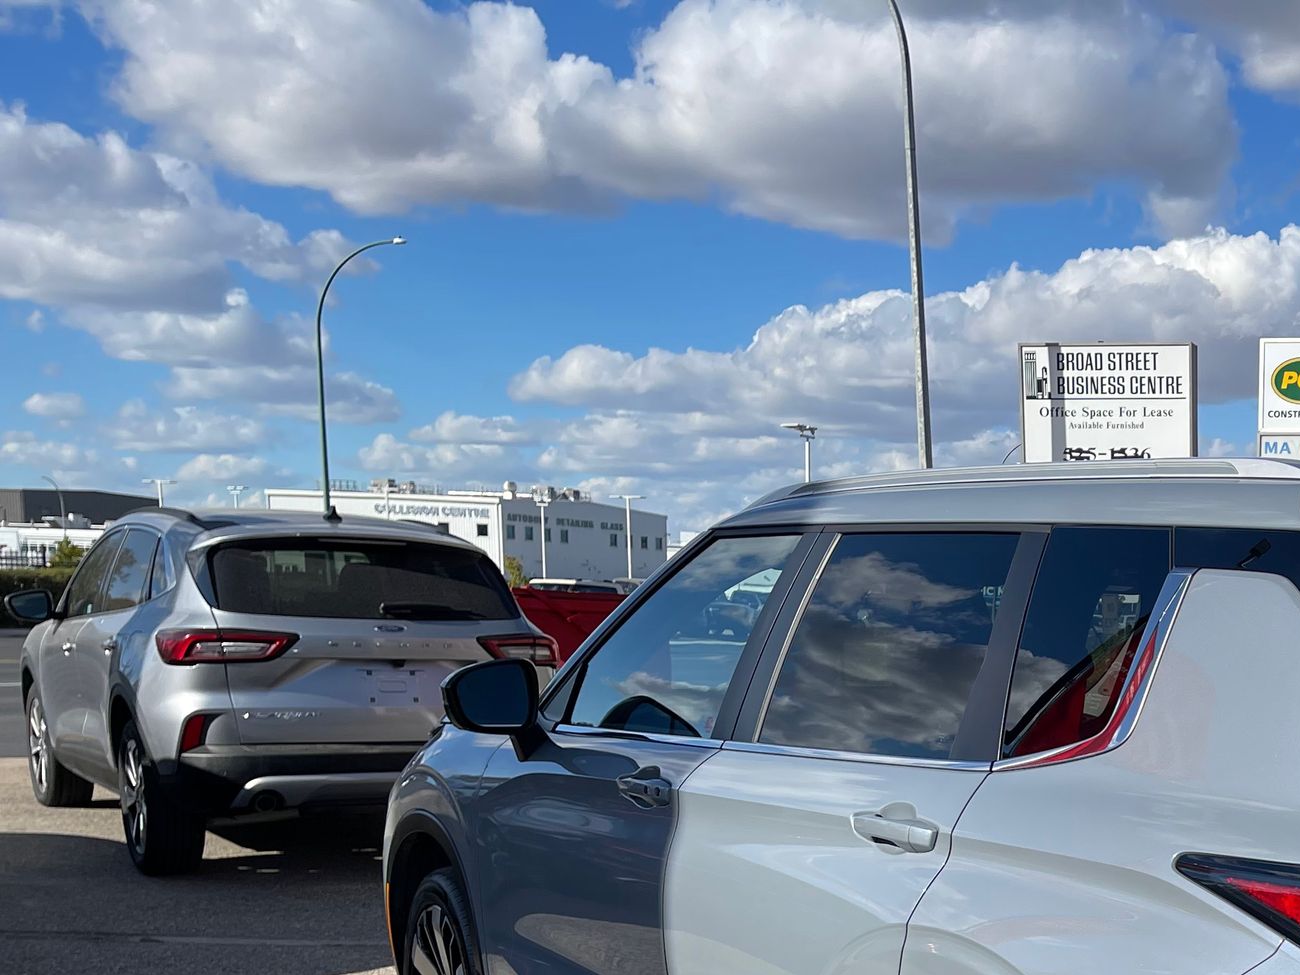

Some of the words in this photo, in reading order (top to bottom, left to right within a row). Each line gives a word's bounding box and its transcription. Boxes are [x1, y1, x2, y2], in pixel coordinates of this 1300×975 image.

[1057, 352, 1103, 371] BROAD
[1108, 352, 1159, 371] STREET
[1057, 376, 1125, 395] BUSINESS
[1130, 376, 1183, 395] CENTRE
[1039, 406, 1077, 418] Office
[1081, 406, 1114, 420] Space
[1119, 406, 1138, 418] For
[1143, 406, 1174, 418] Lease
[1068, 421, 1103, 430] Available
[1106, 421, 1145, 430] Furnished
[506, 513, 549, 525] AUTOBOY
[600, 521, 624, 531] GLASS
